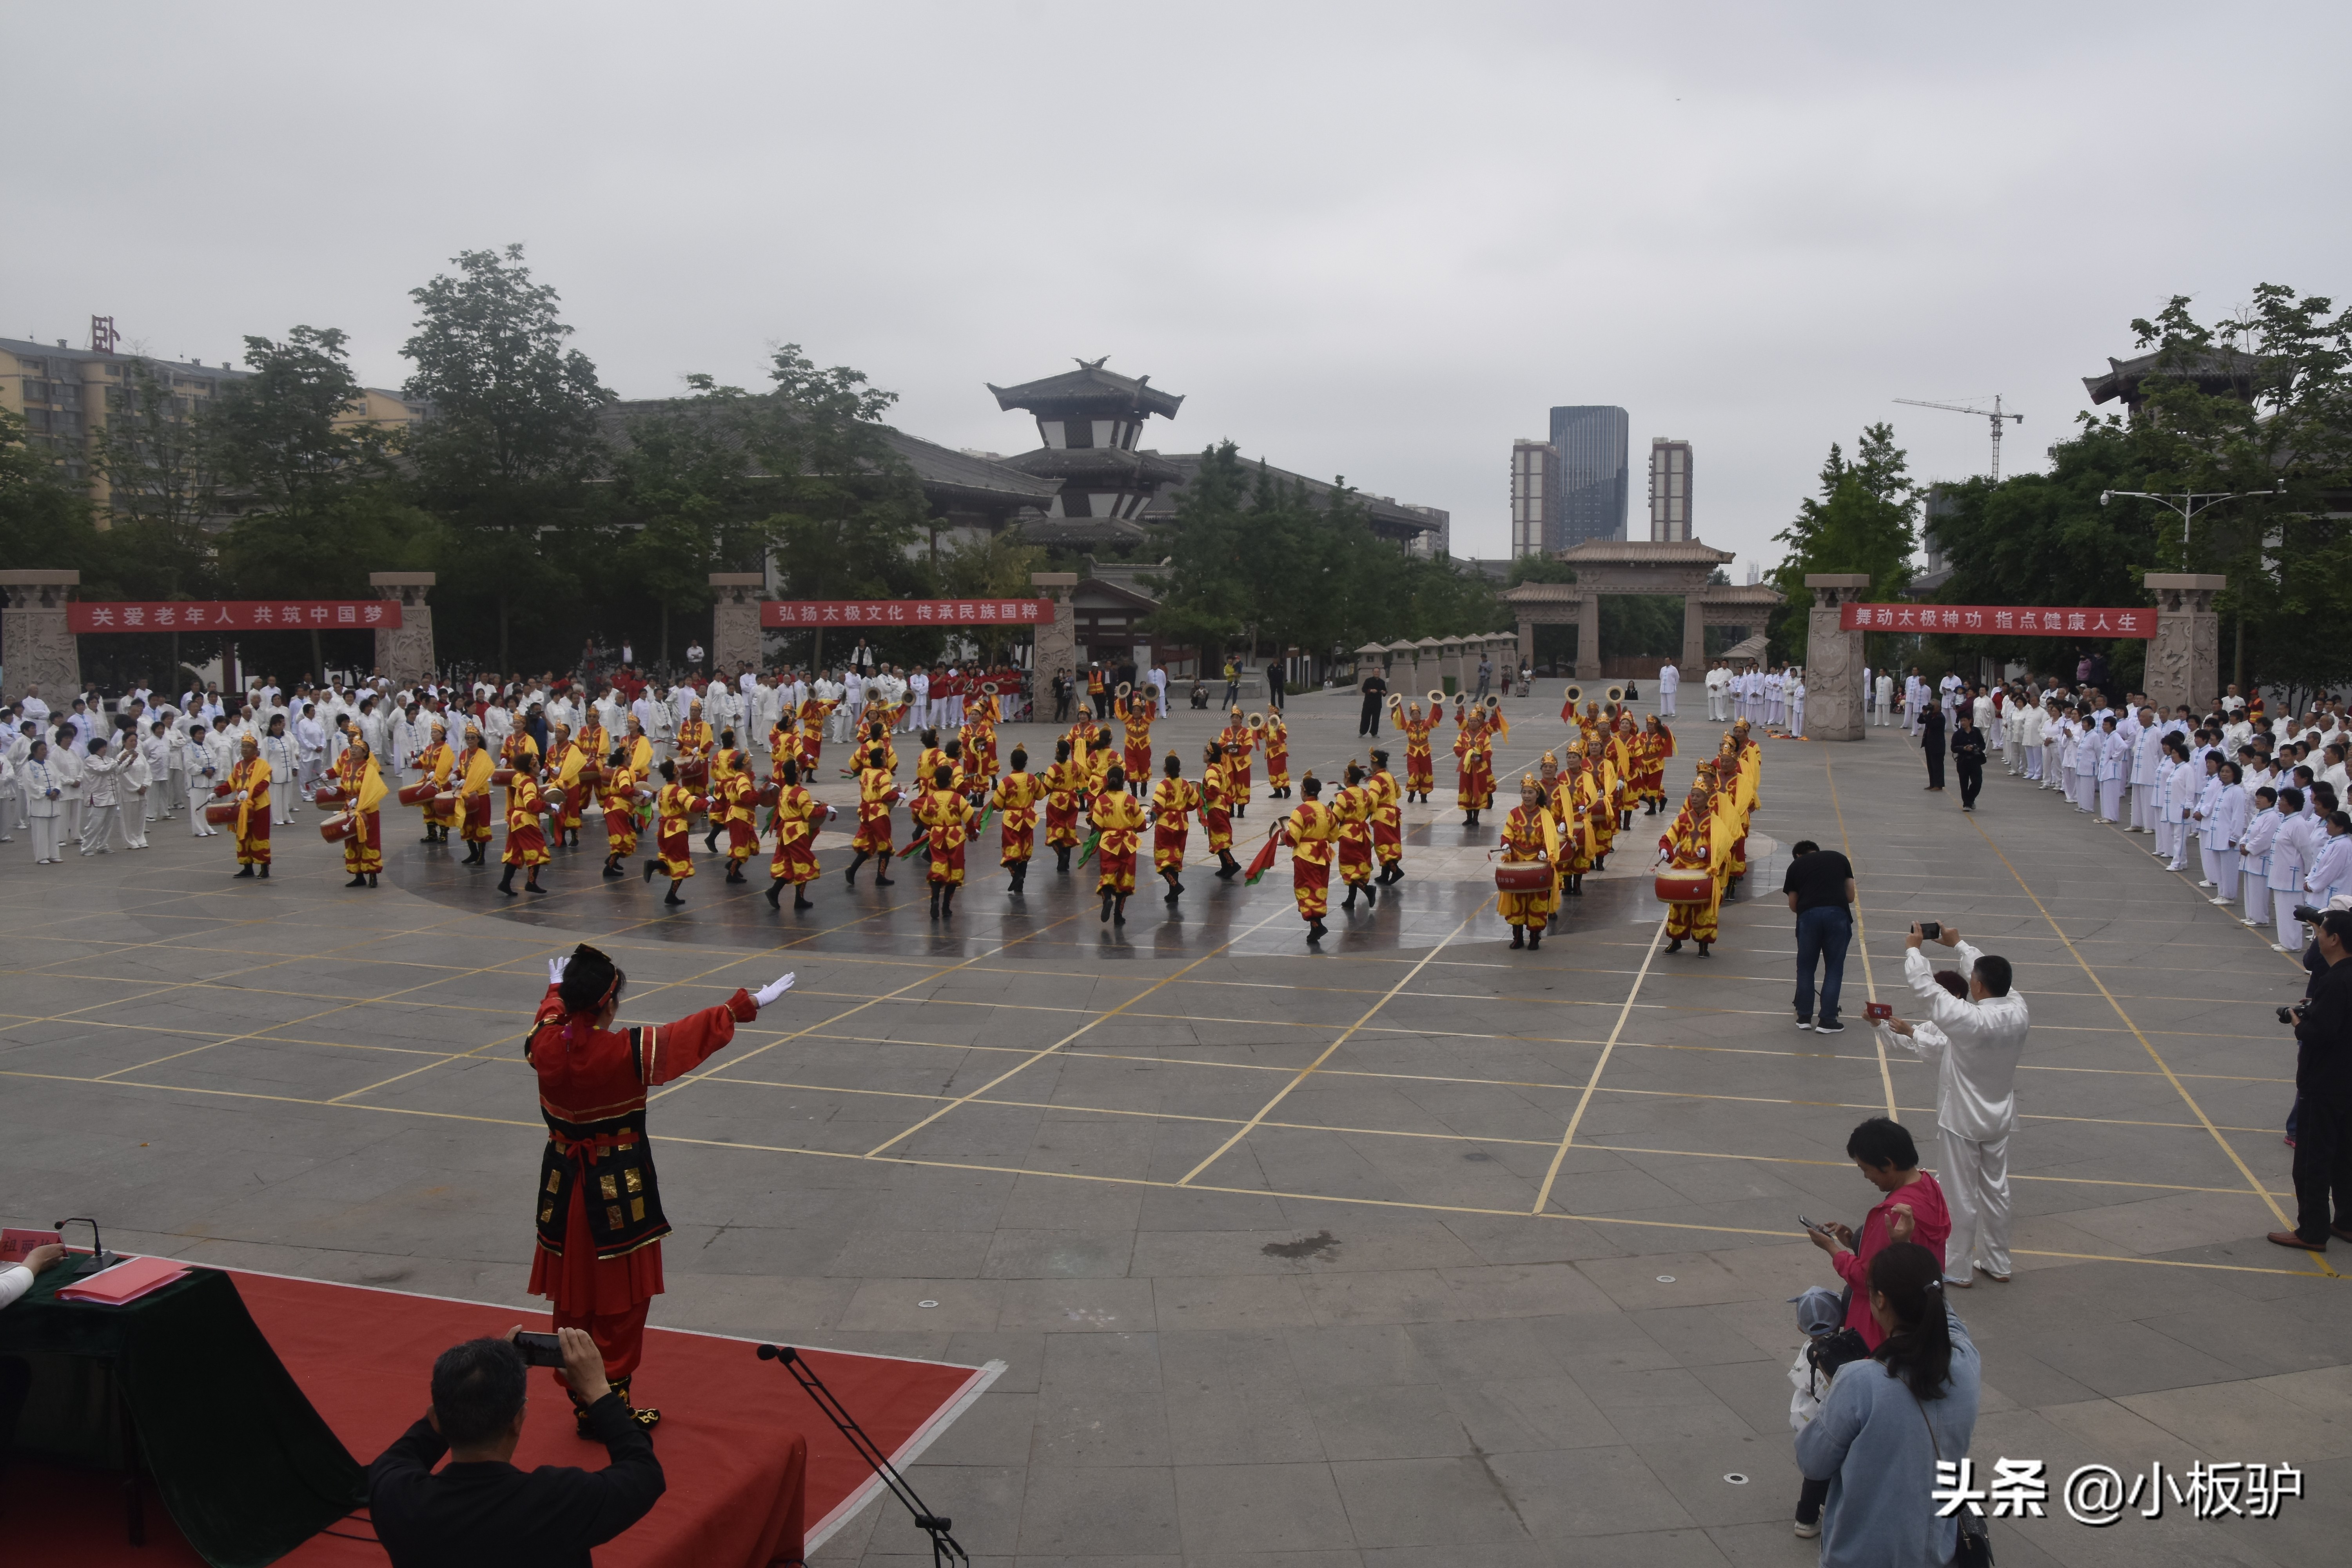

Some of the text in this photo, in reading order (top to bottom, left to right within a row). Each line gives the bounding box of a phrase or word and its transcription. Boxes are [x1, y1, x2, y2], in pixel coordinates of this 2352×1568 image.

[92, 605, 383, 626] 关爱老年人 共筑中国梦
[779, 603, 1038, 621] 弘扬太极文化 传承民族国粹
[1855, 608, 2137, 632] 舞动太极神功 指点健康人生
